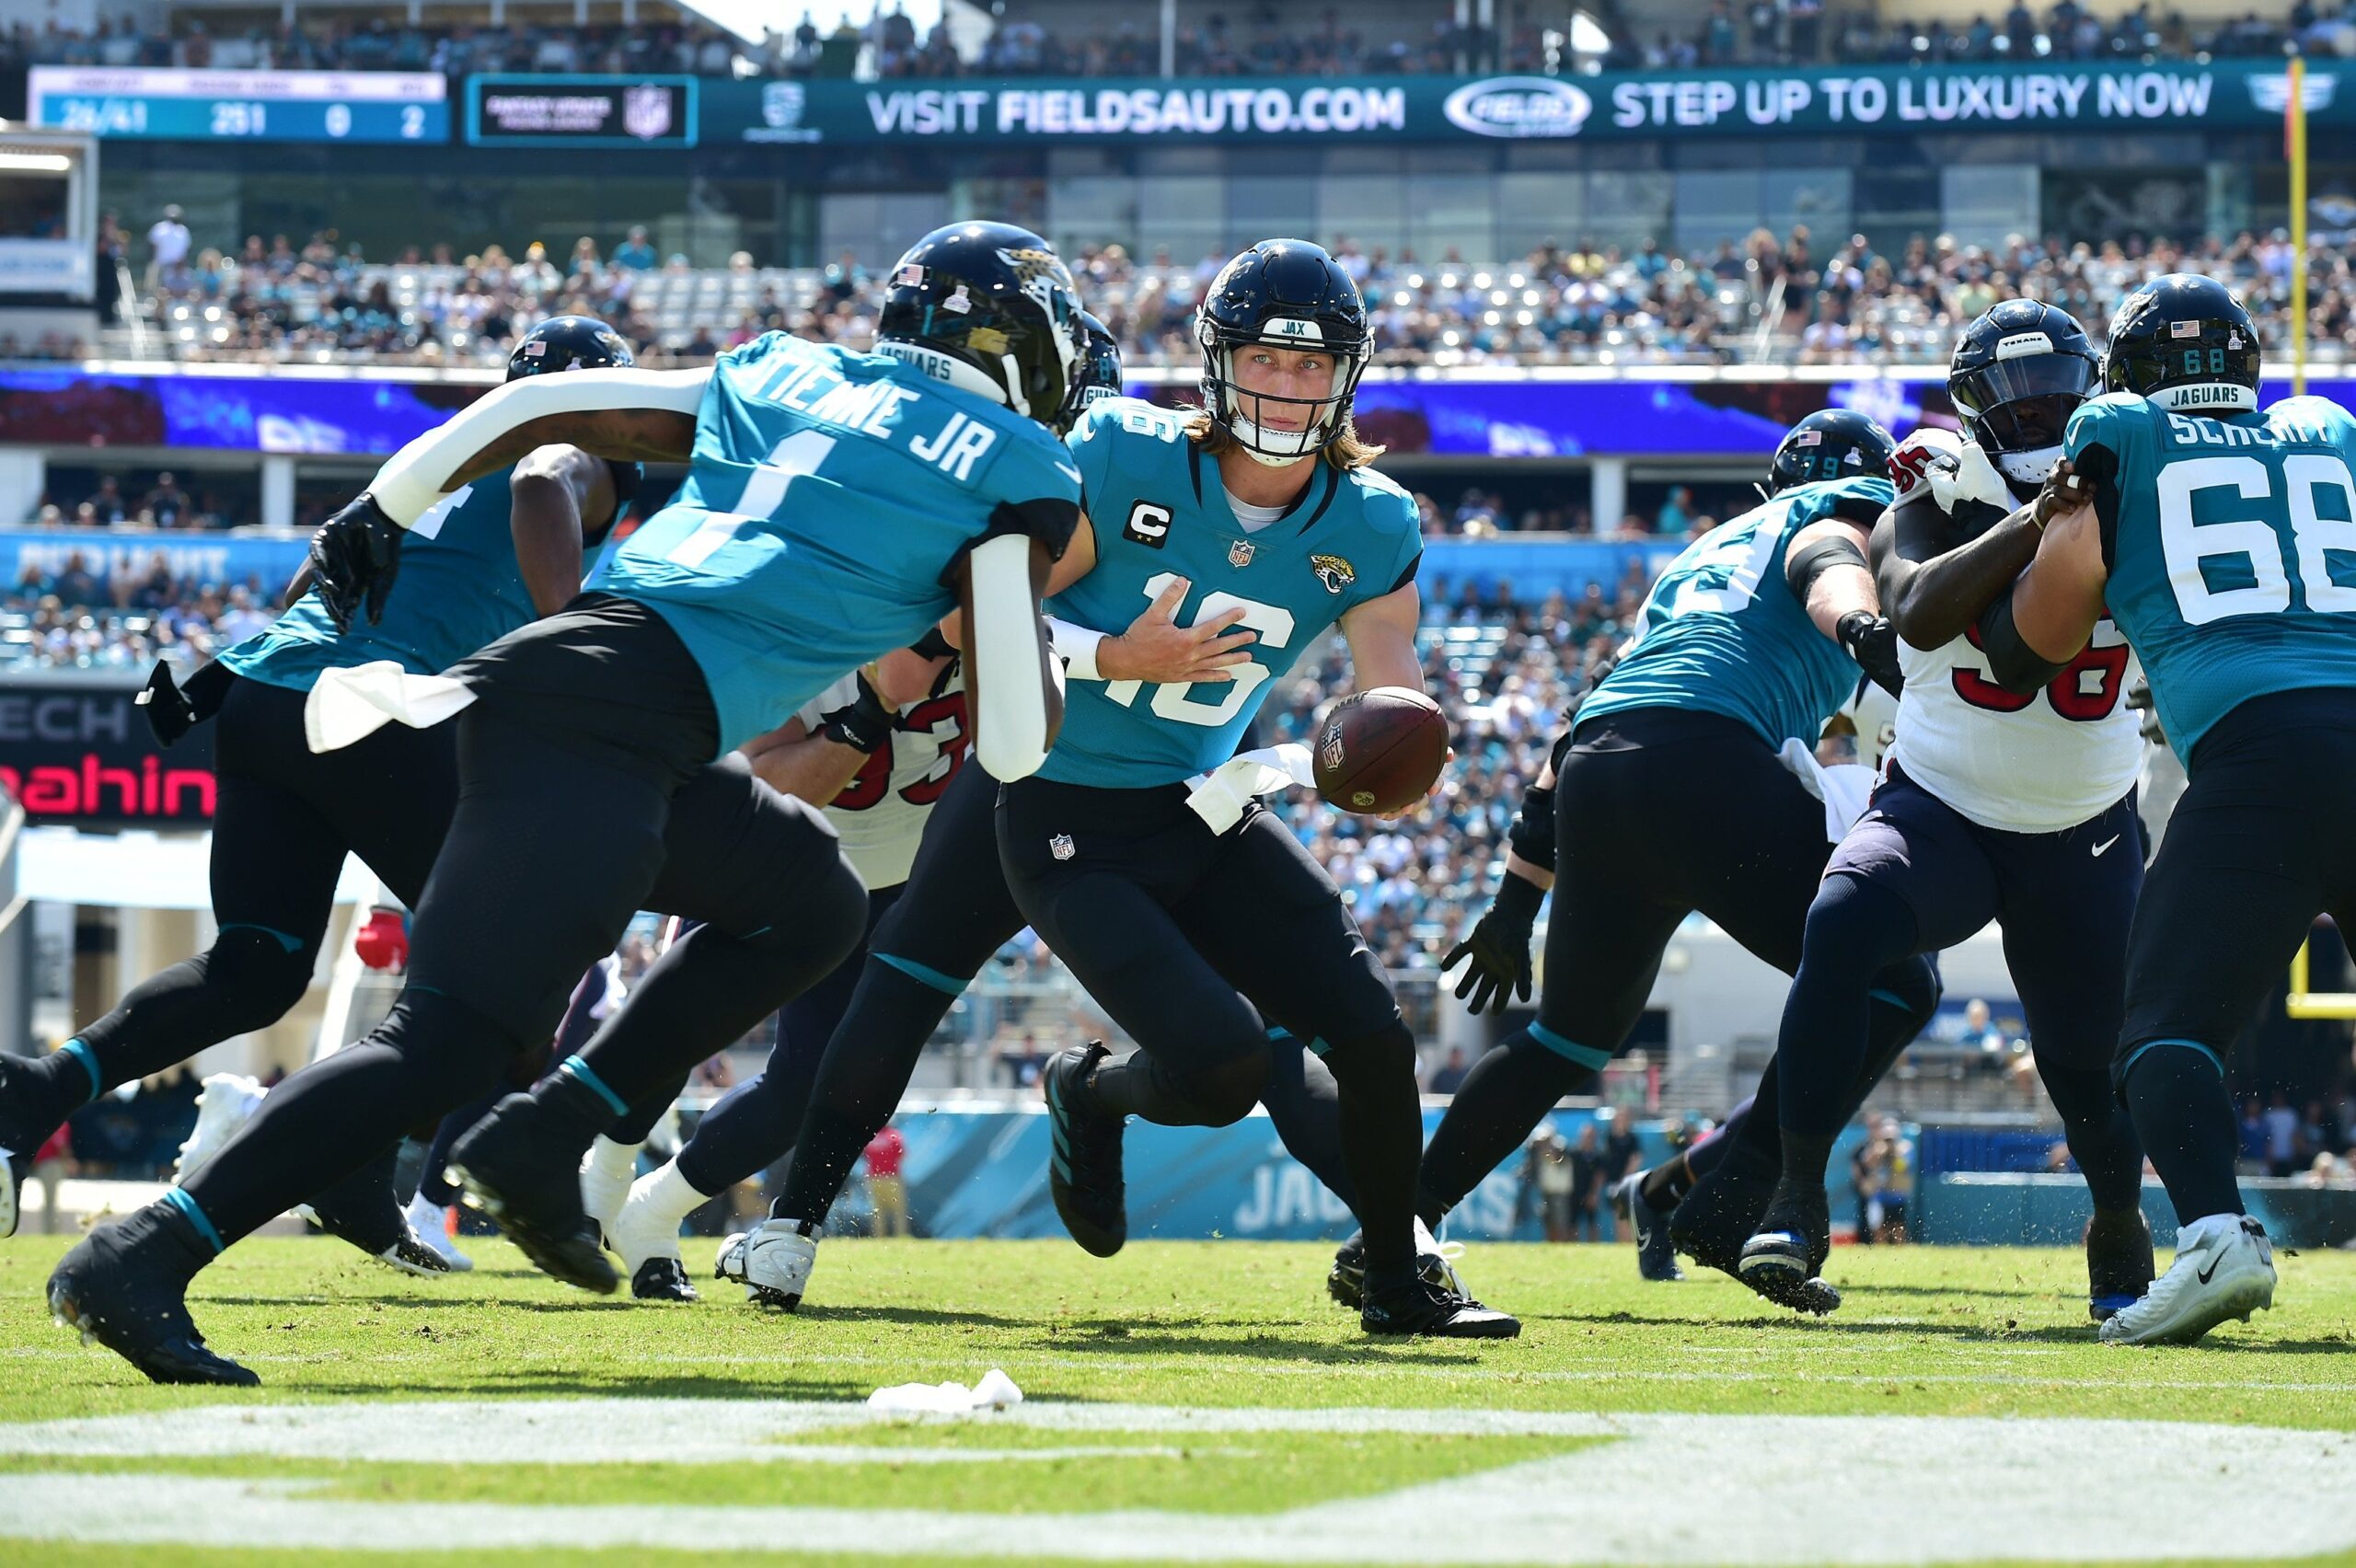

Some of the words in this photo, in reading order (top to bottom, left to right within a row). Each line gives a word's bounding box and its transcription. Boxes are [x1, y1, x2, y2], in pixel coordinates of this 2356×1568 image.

[867, 90, 988, 133] VISIT
[998, 87, 1405, 133] FIELDSAUTO.COM
[1612, 81, 1737, 127] STEP
[1746, 79, 1811, 124] UP
[1818, 76, 1887, 121] TO
[1898, 74, 2088, 121] LUXURY
[2098, 72, 2212, 119] NOW
[400, 105, 425, 138] 2
[1282, 321, 1305, 336] JAX
[2003, 337, 2042, 347] TEXANS
[2184, 349, 2224, 375] 68
[2171, 386, 2238, 405] JAGUARS
[908, 411, 997, 481] JR
[1803, 455, 1839, 478] 79
[665, 428, 837, 569] 1
[1130, 503, 1170, 537] C
[2156, 454, 2356, 626] 68
[1104, 571, 1295, 726] 16
[1324, 741, 1343, 767] NFL
[0, 753, 217, 816] ahin
